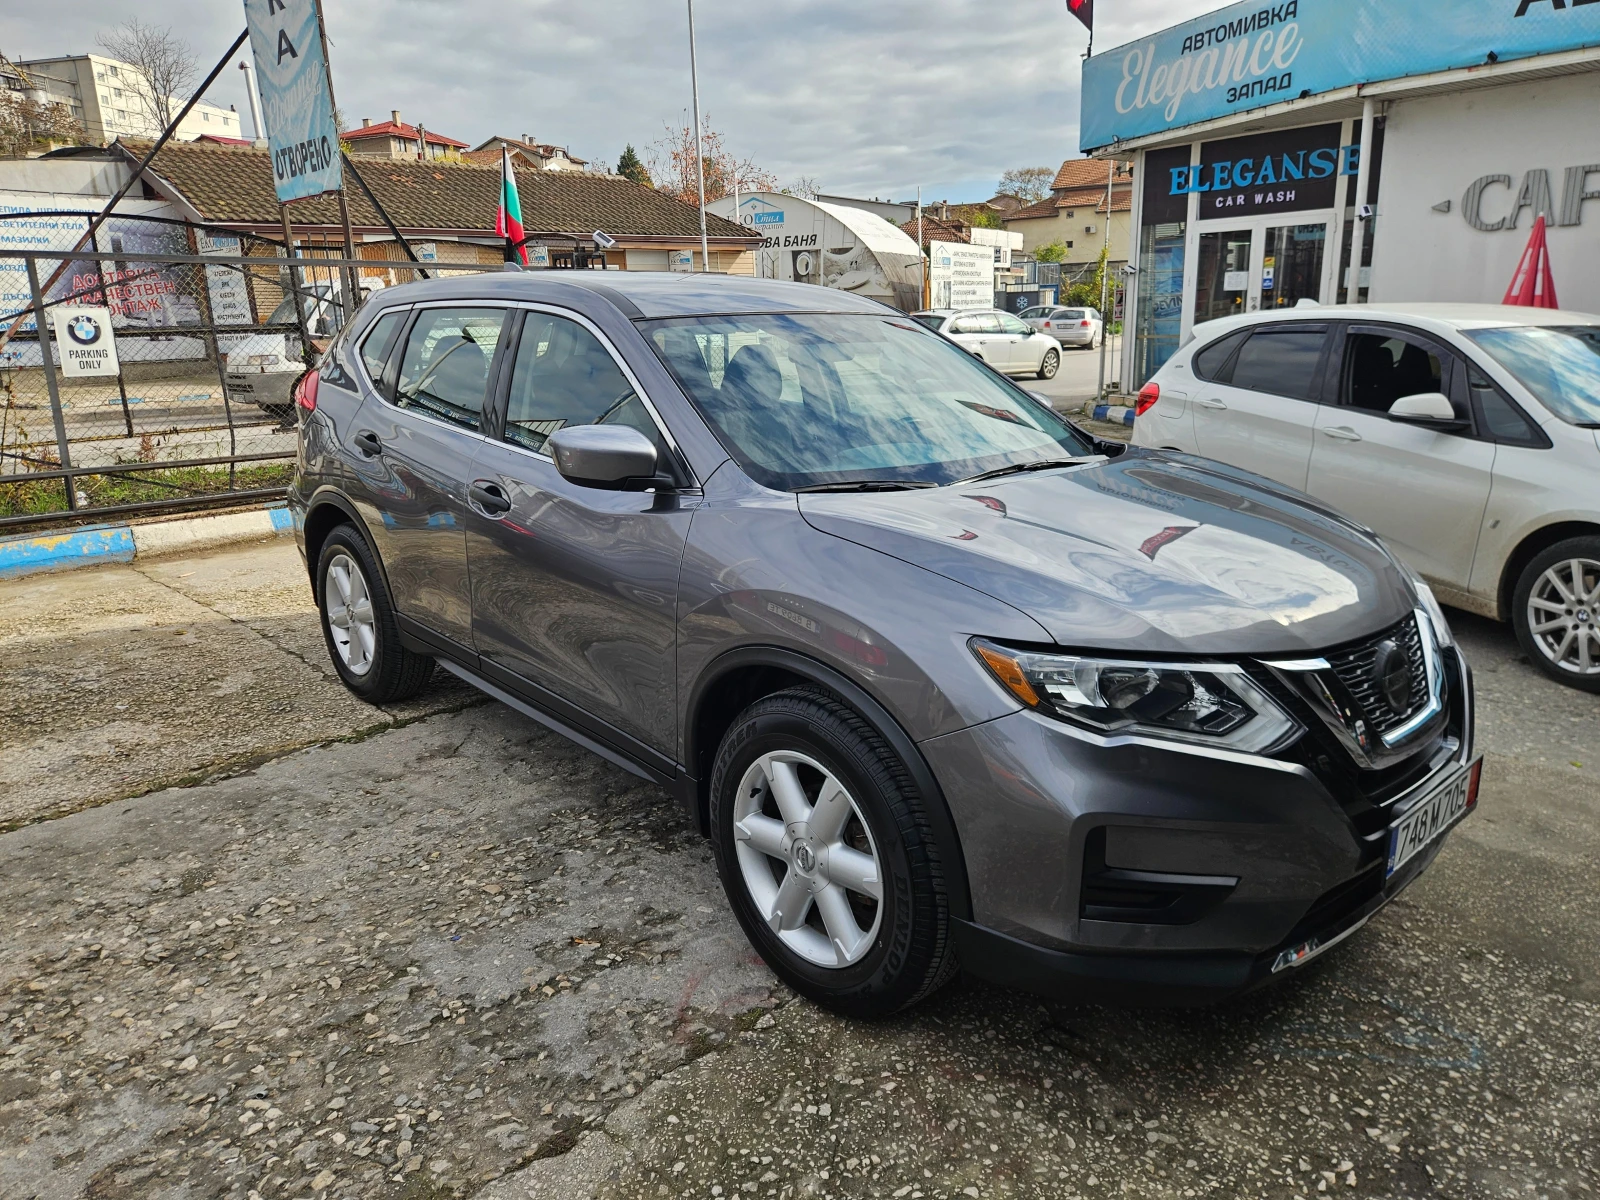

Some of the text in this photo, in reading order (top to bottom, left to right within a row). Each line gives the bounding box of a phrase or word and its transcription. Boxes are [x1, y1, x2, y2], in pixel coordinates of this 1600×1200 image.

[1181, 0, 1298, 56] АВТОМИВКА
[1115, 22, 1304, 122] Elegance
[1226, 72, 1293, 104] ЗАПАД
[275, 135, 331, 181] ОТВОРЕНО
[1169, 145, 1361, 196] ELEGANSE
[1215, 190, 1296, 208] CAR WASH
[60, 222, 84, 230] ТЕЛА
[756, 213, 779, 224] Стил
[1, 236, 50, 244] МАЗИЛКИ
[784, 234, 818, 247] БАНЯ
[69, 315, 99, 327] BMW
[69, 349, 108, 359] PARKING
[79, 360, 101, 369] ONLY
[1398, 808, 1428, 862] 748
[1441, 775, 1468, 825] 705
